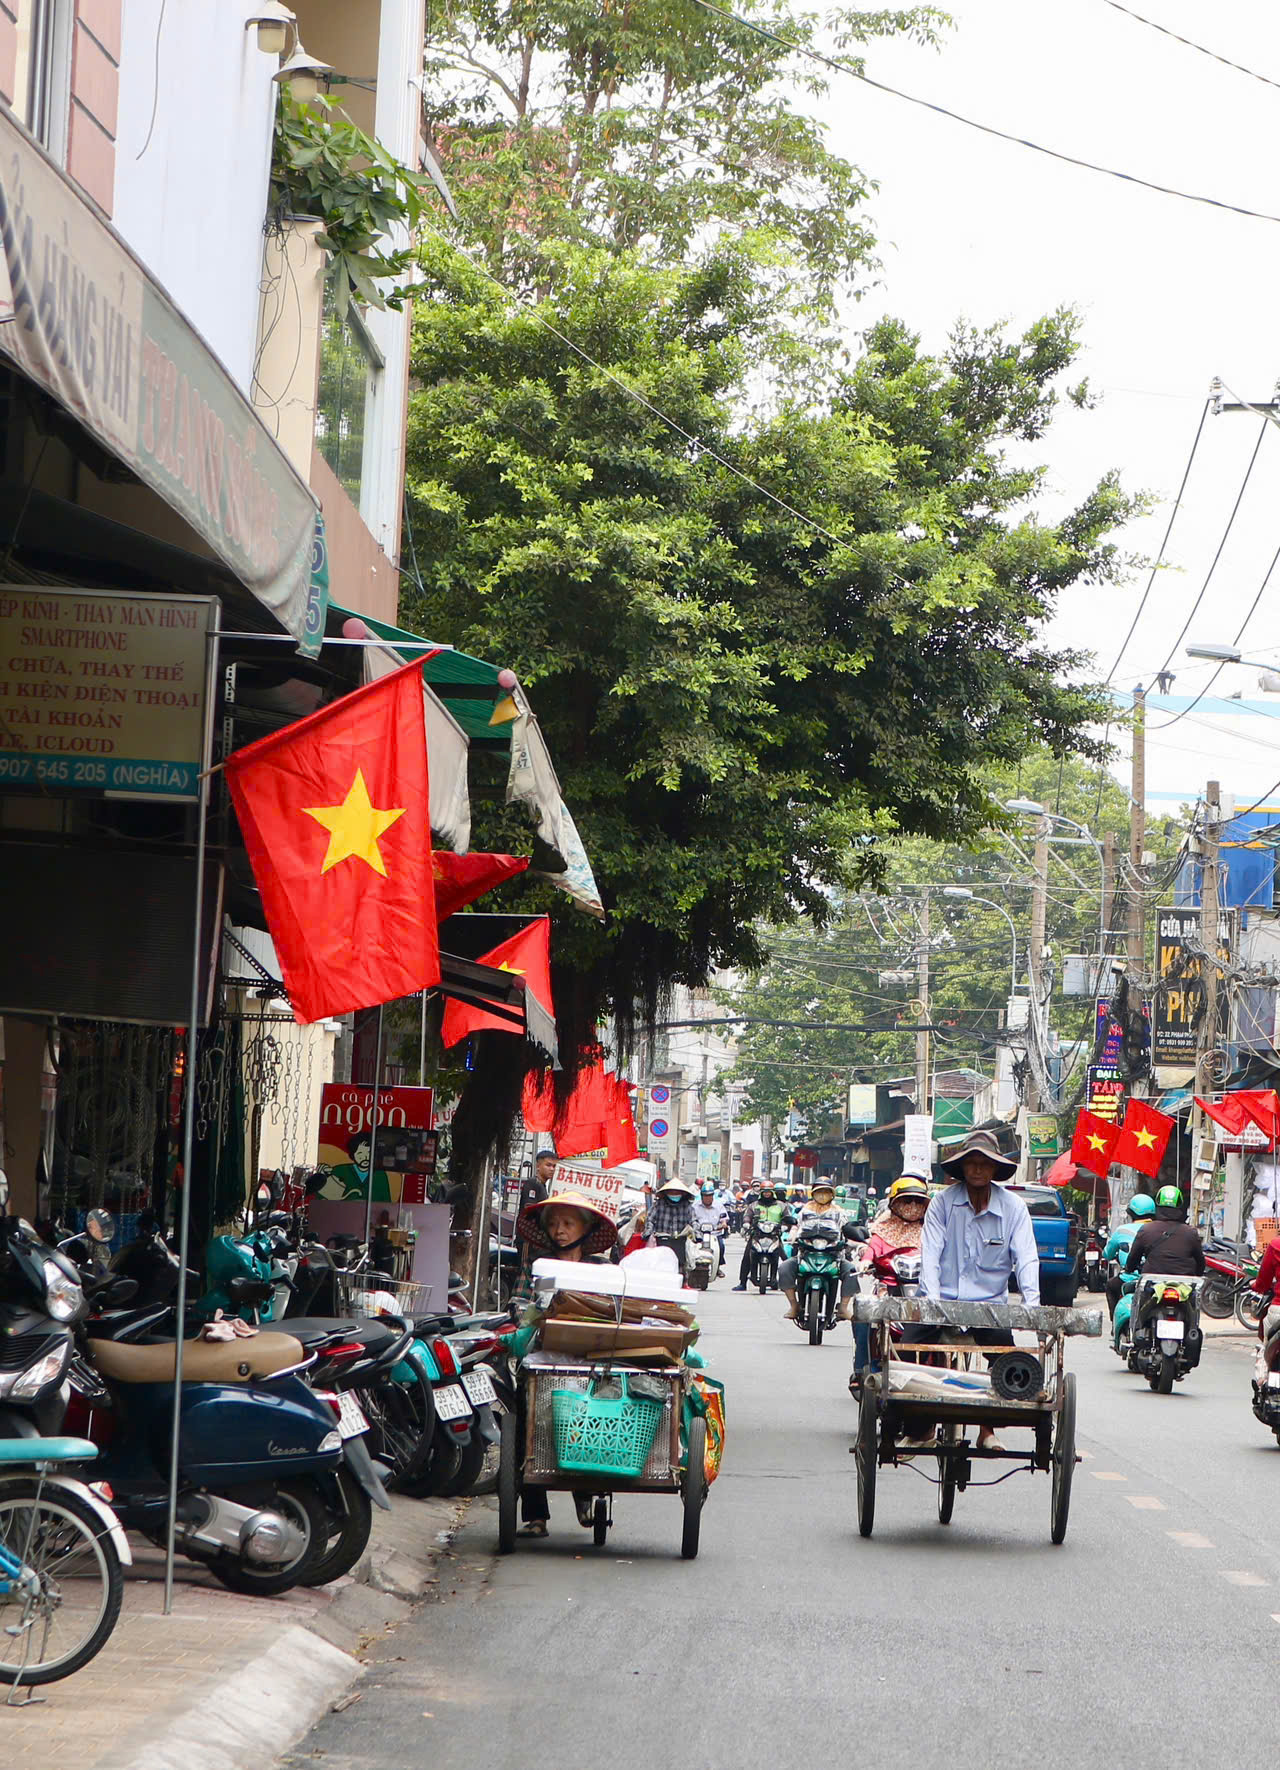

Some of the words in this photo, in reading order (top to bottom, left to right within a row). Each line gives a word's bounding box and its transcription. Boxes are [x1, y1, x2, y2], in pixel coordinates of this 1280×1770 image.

[23, 596, 60, 620] KÍNH
[74, 603, 116, 624] THAY
[120, 602, 155, 625] MÀN
[21, 626, 128, 651] SMARTPHONE
[80, 661, 135, 679] THAY
[143, 660, 185, 681] THẾ
[134, 690, 200, 710] THOẠI
[48, 708, 123, 728] KHOẢN
[36, 736, 114, 753] ICLOUD
[37, 761, 68, 779] 545
[74, 764, 106, 782] 205
[113, 764, 188, 789] (NGHĨA)
[268, 1441, 310, 1455] Vespa
